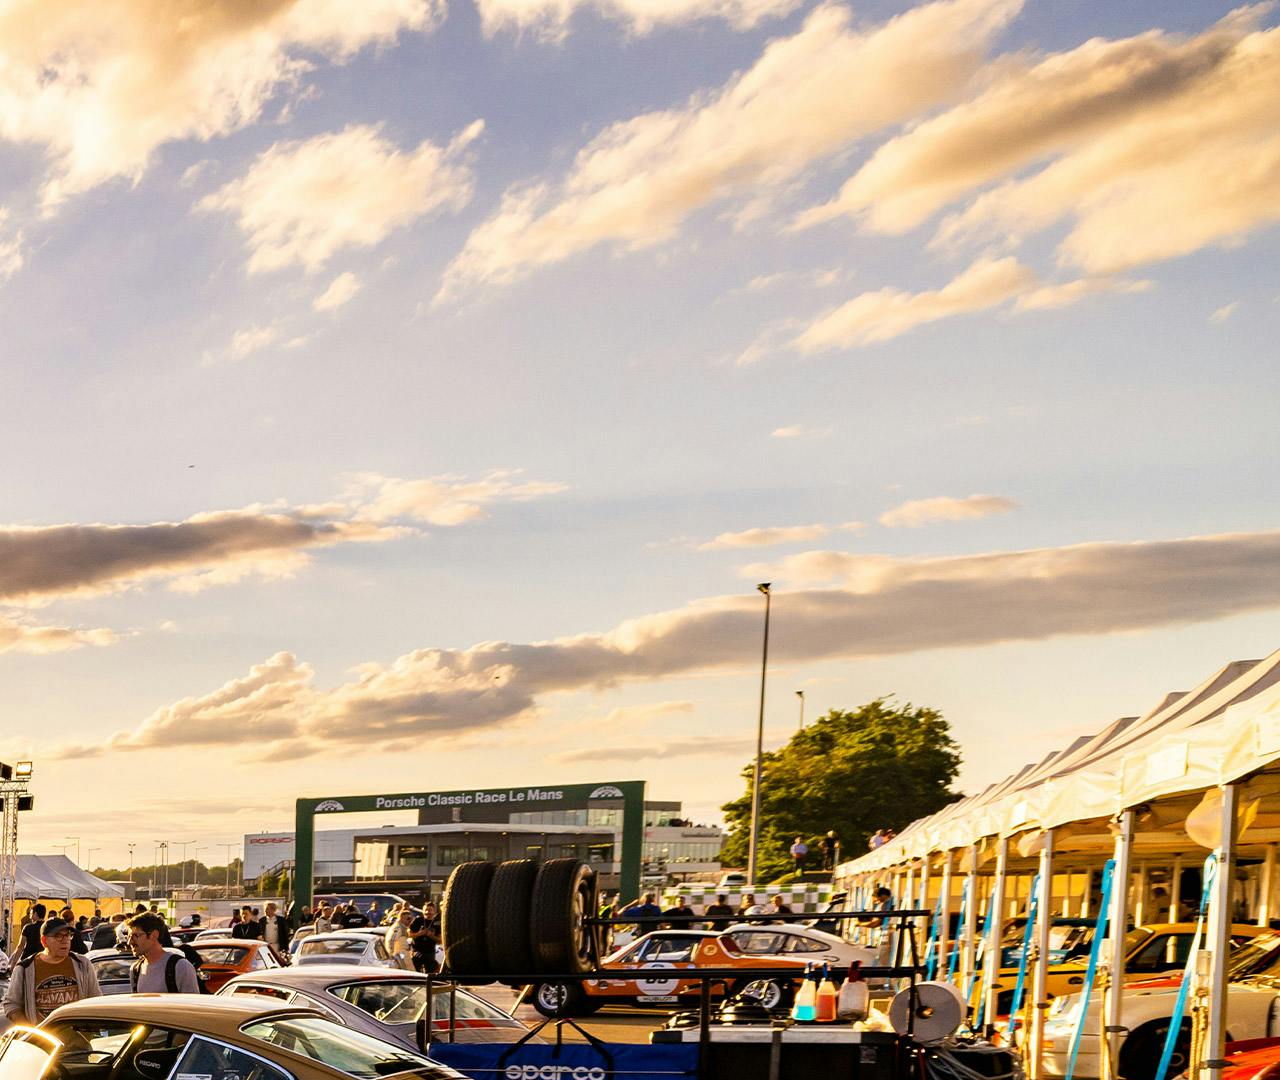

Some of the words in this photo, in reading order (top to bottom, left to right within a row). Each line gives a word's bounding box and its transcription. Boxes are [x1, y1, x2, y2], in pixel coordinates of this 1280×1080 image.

[376, 794, 425, 808] Porsche
[428, 791, 473, 806] Classic
[475, 791, 507, 804] Race
[509, 790, 526, 802] Le
[528, 788, 563, 801] Mans
